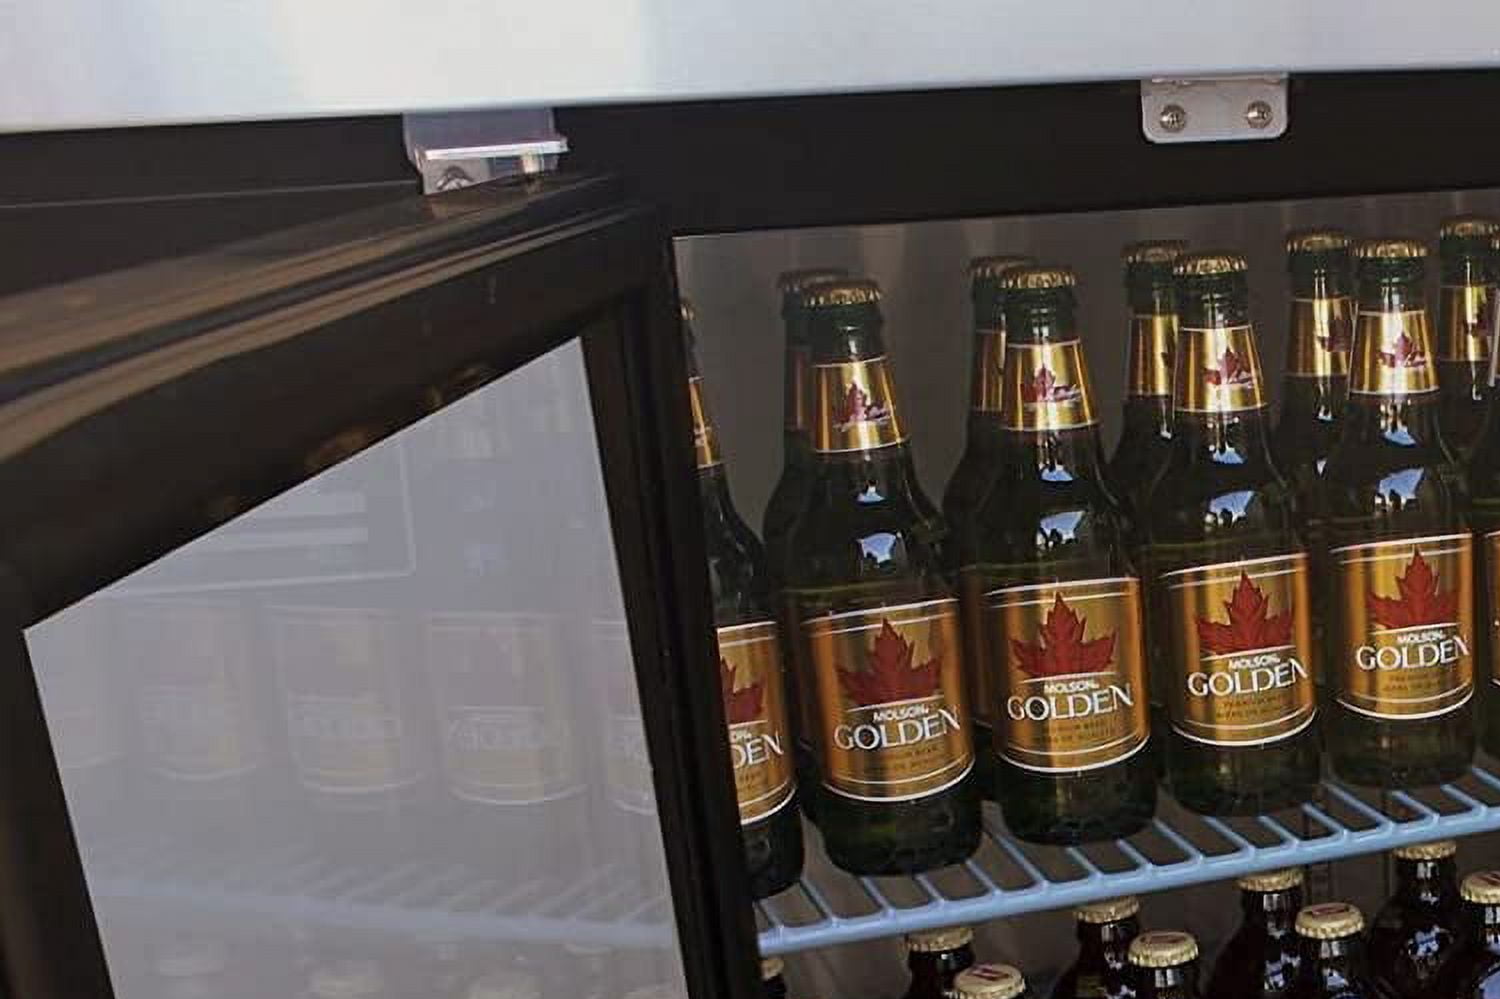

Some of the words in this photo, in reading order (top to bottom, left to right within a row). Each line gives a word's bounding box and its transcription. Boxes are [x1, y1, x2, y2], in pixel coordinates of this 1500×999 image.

[1356, 634, 1469, 670] GOLDEN
[1187, 657, 1308, 697] GOLDEN
[1007, 684, 1135, 720] GOLDEN
[833, 708, 960, 750] GOLDEN
[731, 730, 783, 769] DEN
